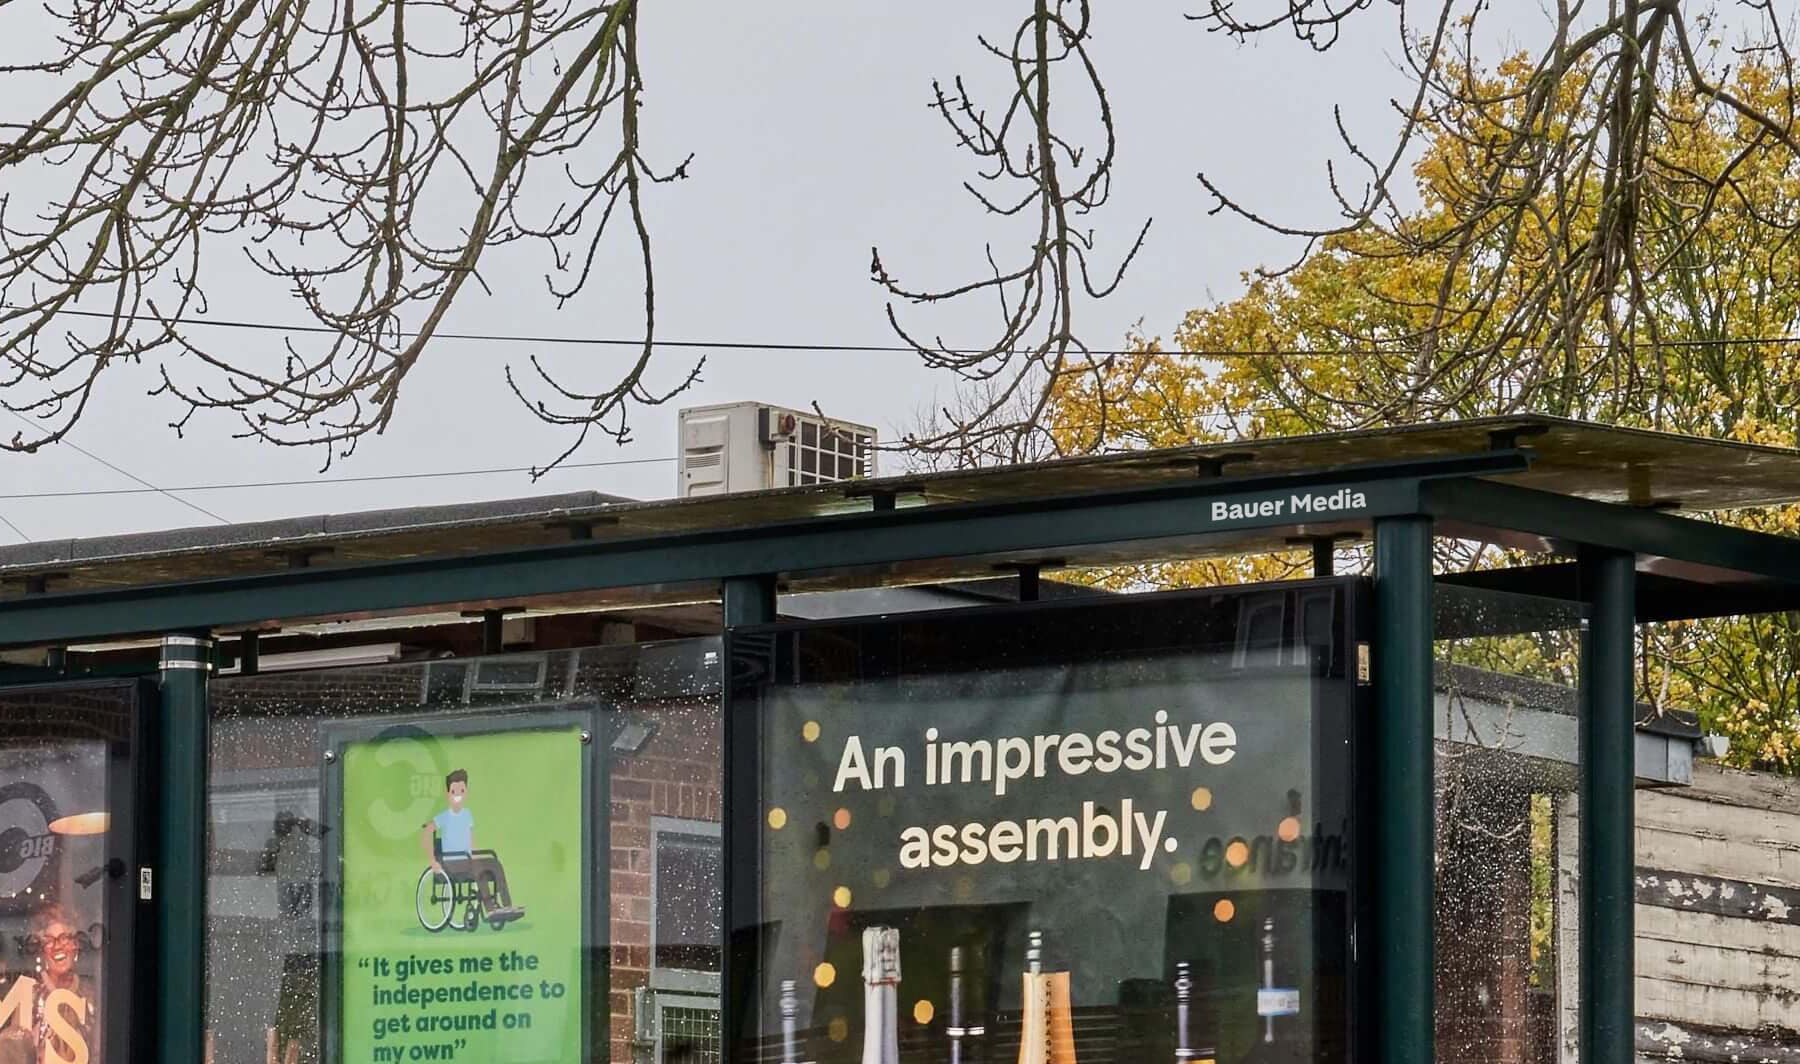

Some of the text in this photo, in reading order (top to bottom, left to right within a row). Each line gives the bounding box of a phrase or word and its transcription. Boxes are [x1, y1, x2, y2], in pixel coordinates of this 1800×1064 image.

[1211, 487, 1367, 522] Bauer Media
[833, 709, 1237, 796] An impressive
[899, 798, 1178, 871] assembly.
[395, 955, 454, 981] gives
[459, 957, 493, 973] me
[499, 950, 539, 972] the
[373, 980, 566, 1009] independence to
[373, 1008, 532, 1039] get around on
